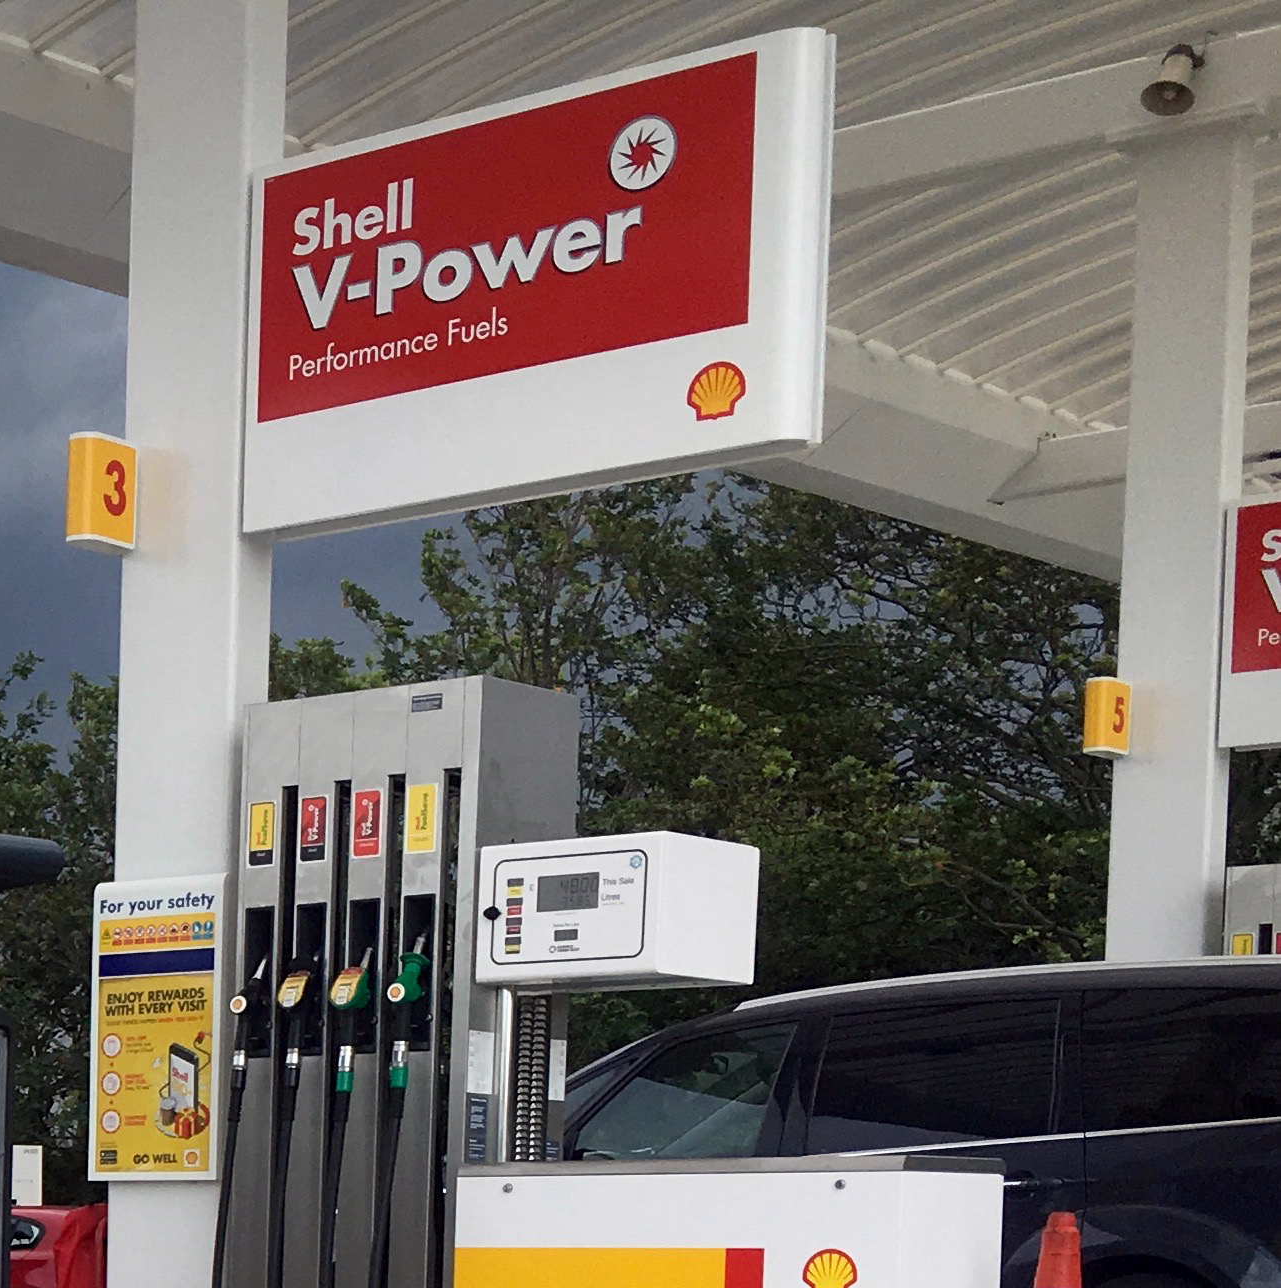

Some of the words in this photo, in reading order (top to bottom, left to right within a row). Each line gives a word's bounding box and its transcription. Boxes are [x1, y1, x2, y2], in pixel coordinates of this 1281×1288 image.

[293, 178, 414, 256] Shell
[292, 207, 643, 330] V-Power
[289, 333, 438, 381] Performance
[447, 307, 508, 346] Fuels
[103, 459, 127, 517] 3
[1112, 696, 1125, 734] 5
[602, 878, 617, 886] This
[618, 877, 635, 885] Sale
[100, 900, 124, 914] For
[128, 899, 163, 915] your
[167, 892, 215, 910] safety
[105, 1004, 135, 1017] WITH
[138, 1002, 173, 1015] EVERY
[177, 999, 207, 1012] VISIT
[107, 991, 144, 1005] ENJOY
[147, 987, 205, 1002] REWARDS
[133, 1154, 150, 1165] GO
[152, 1153, 178, 1164] WELL
